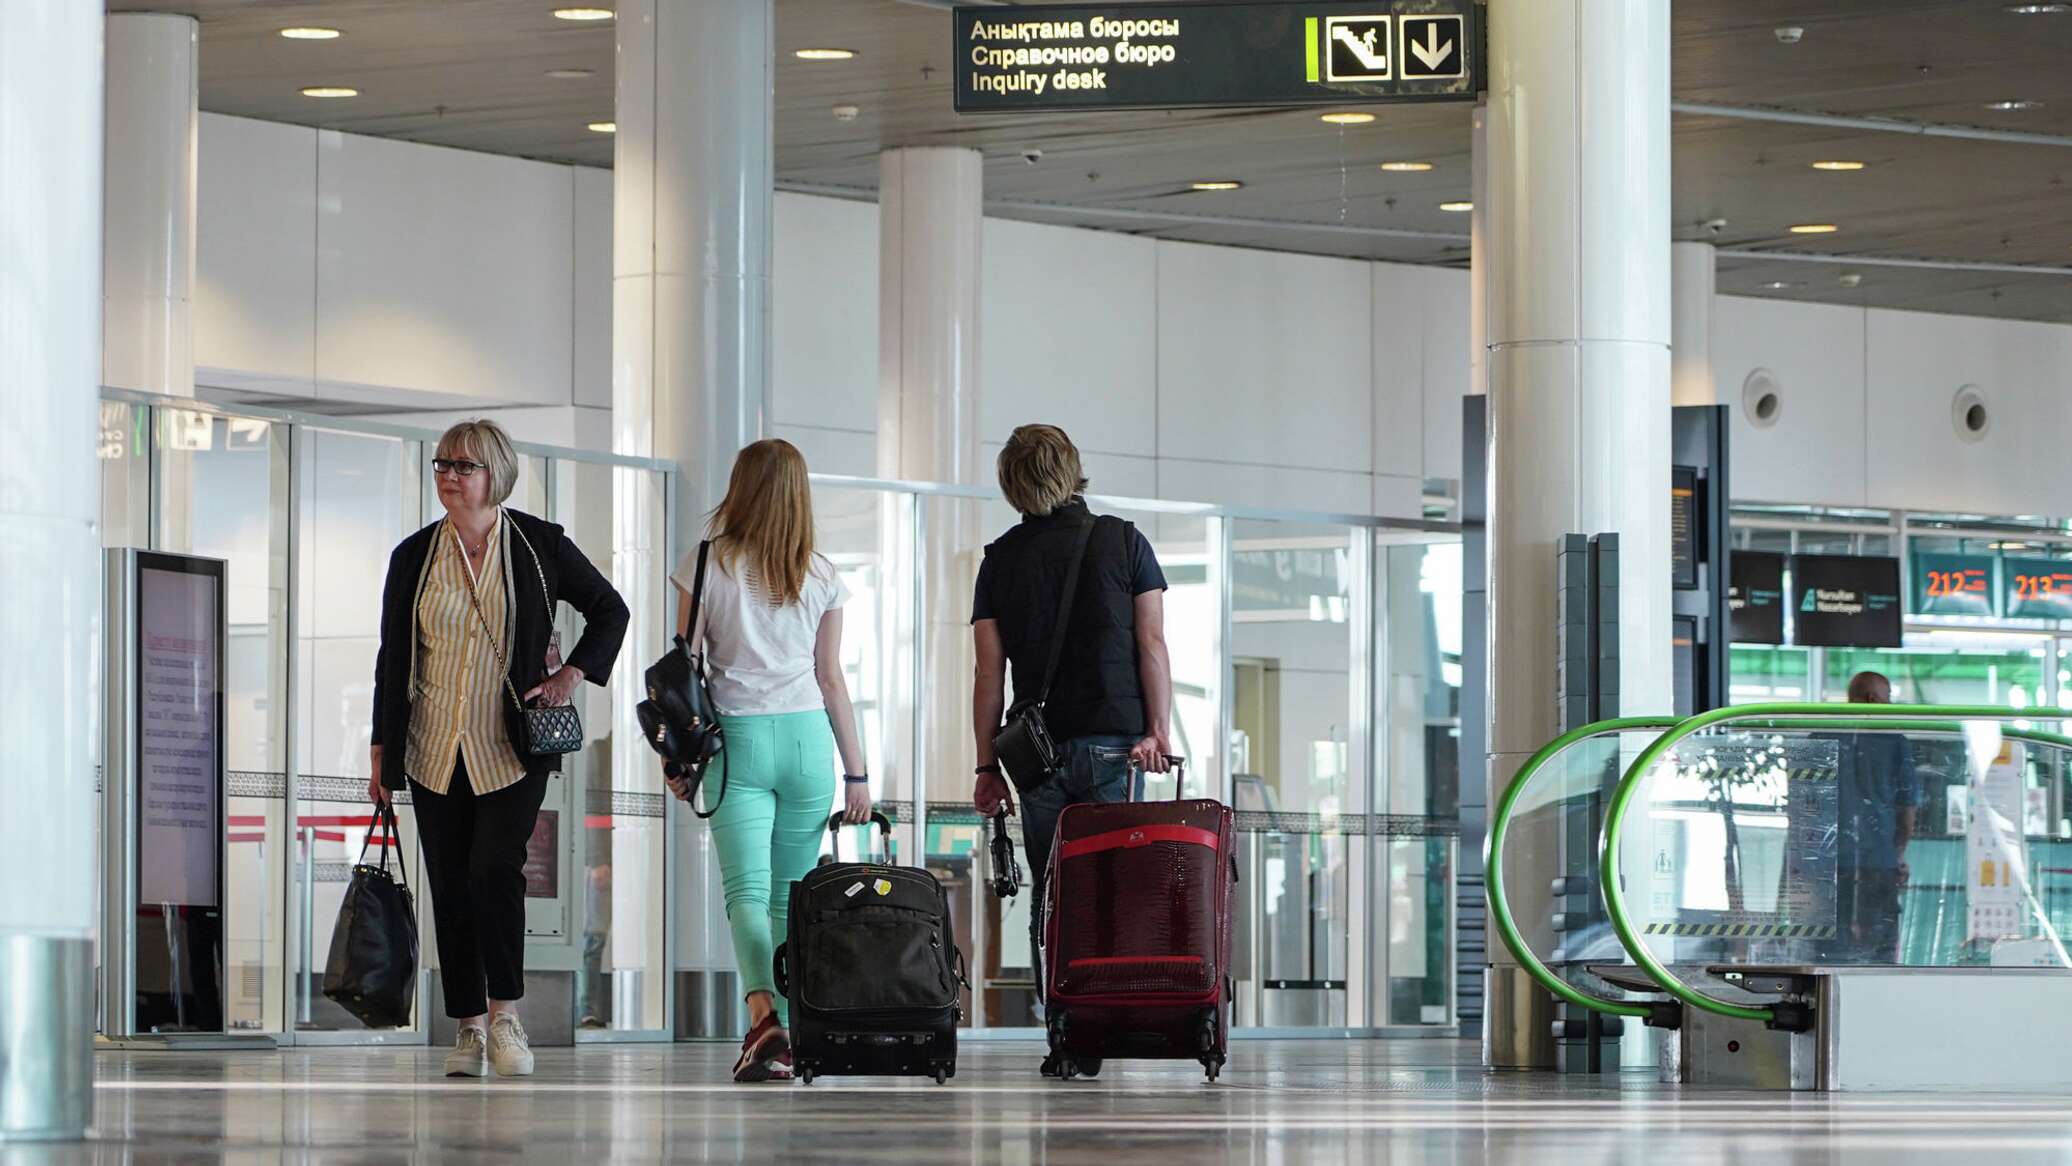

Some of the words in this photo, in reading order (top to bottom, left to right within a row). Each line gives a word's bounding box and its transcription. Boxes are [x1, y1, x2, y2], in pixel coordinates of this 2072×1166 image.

[971, 20, 1084, 42] Анықтама
[1090, 16, 1180, 41] бюросы
[971, 46, 1110, 69] Справочное
[1115, 42, 1176, 66] бюро
[972, 70, 1048, 95] Inquiry
[1052, 68, 1106, 90] desk
[1927, 570, 1966, 597] 212
